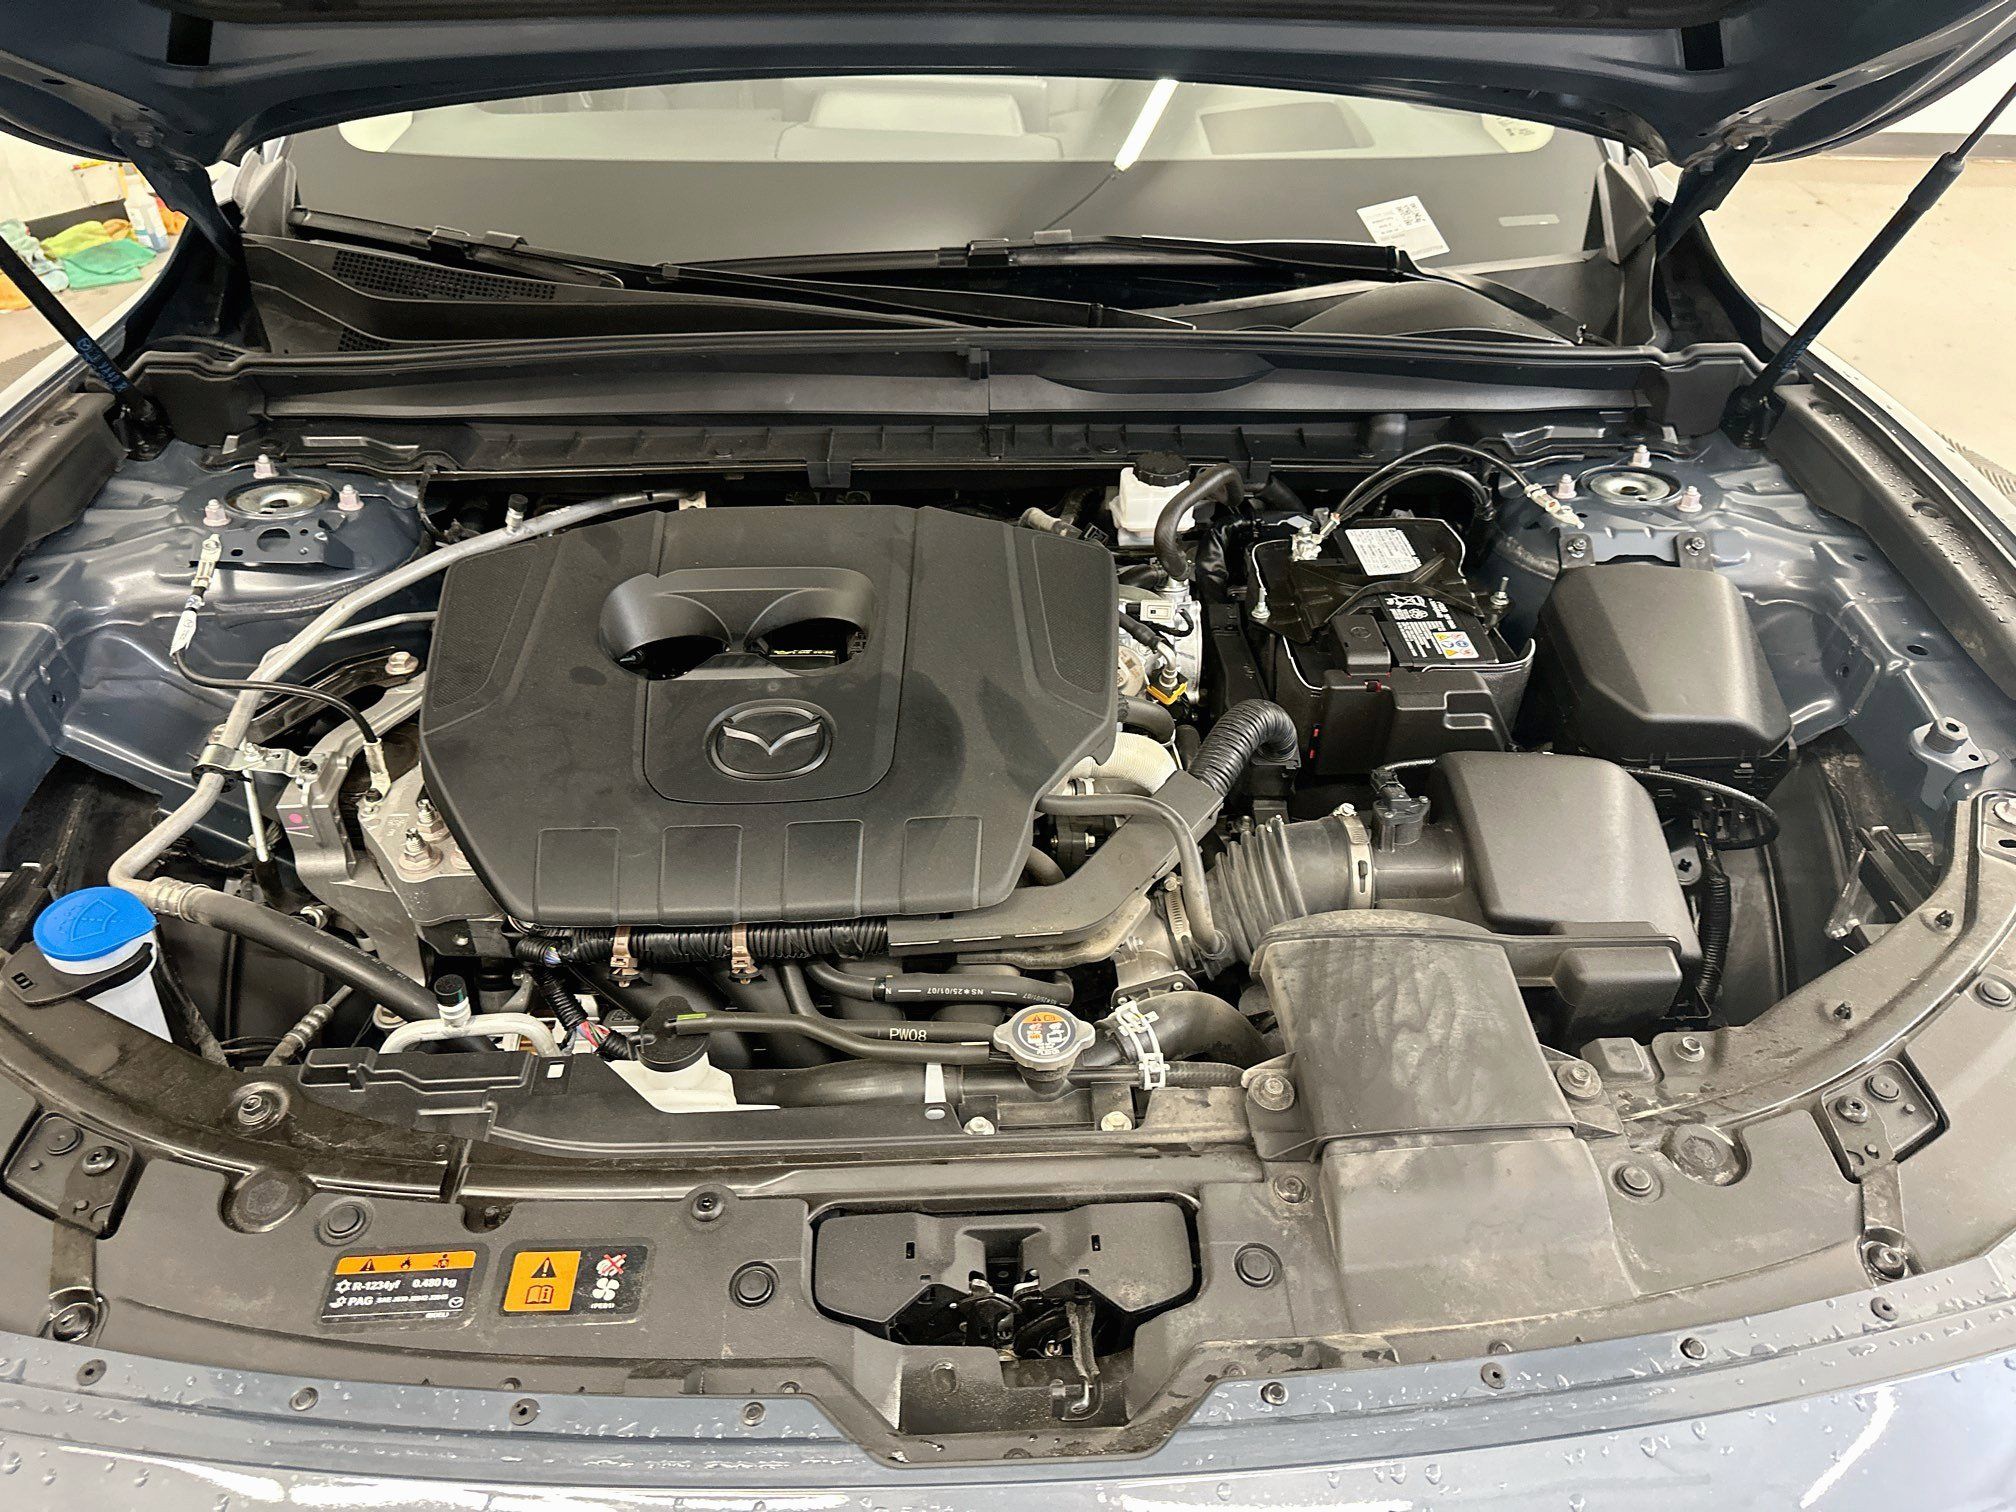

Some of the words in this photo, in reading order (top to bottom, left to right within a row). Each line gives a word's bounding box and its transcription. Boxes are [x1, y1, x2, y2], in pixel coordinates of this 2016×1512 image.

[889, 1027, 928, 1042] PW08
[351, 1279, 401, 1292] R-1234yf
[442, 1277, 458, 1289] kg
[347, 1296, 374, 1306] PAG
